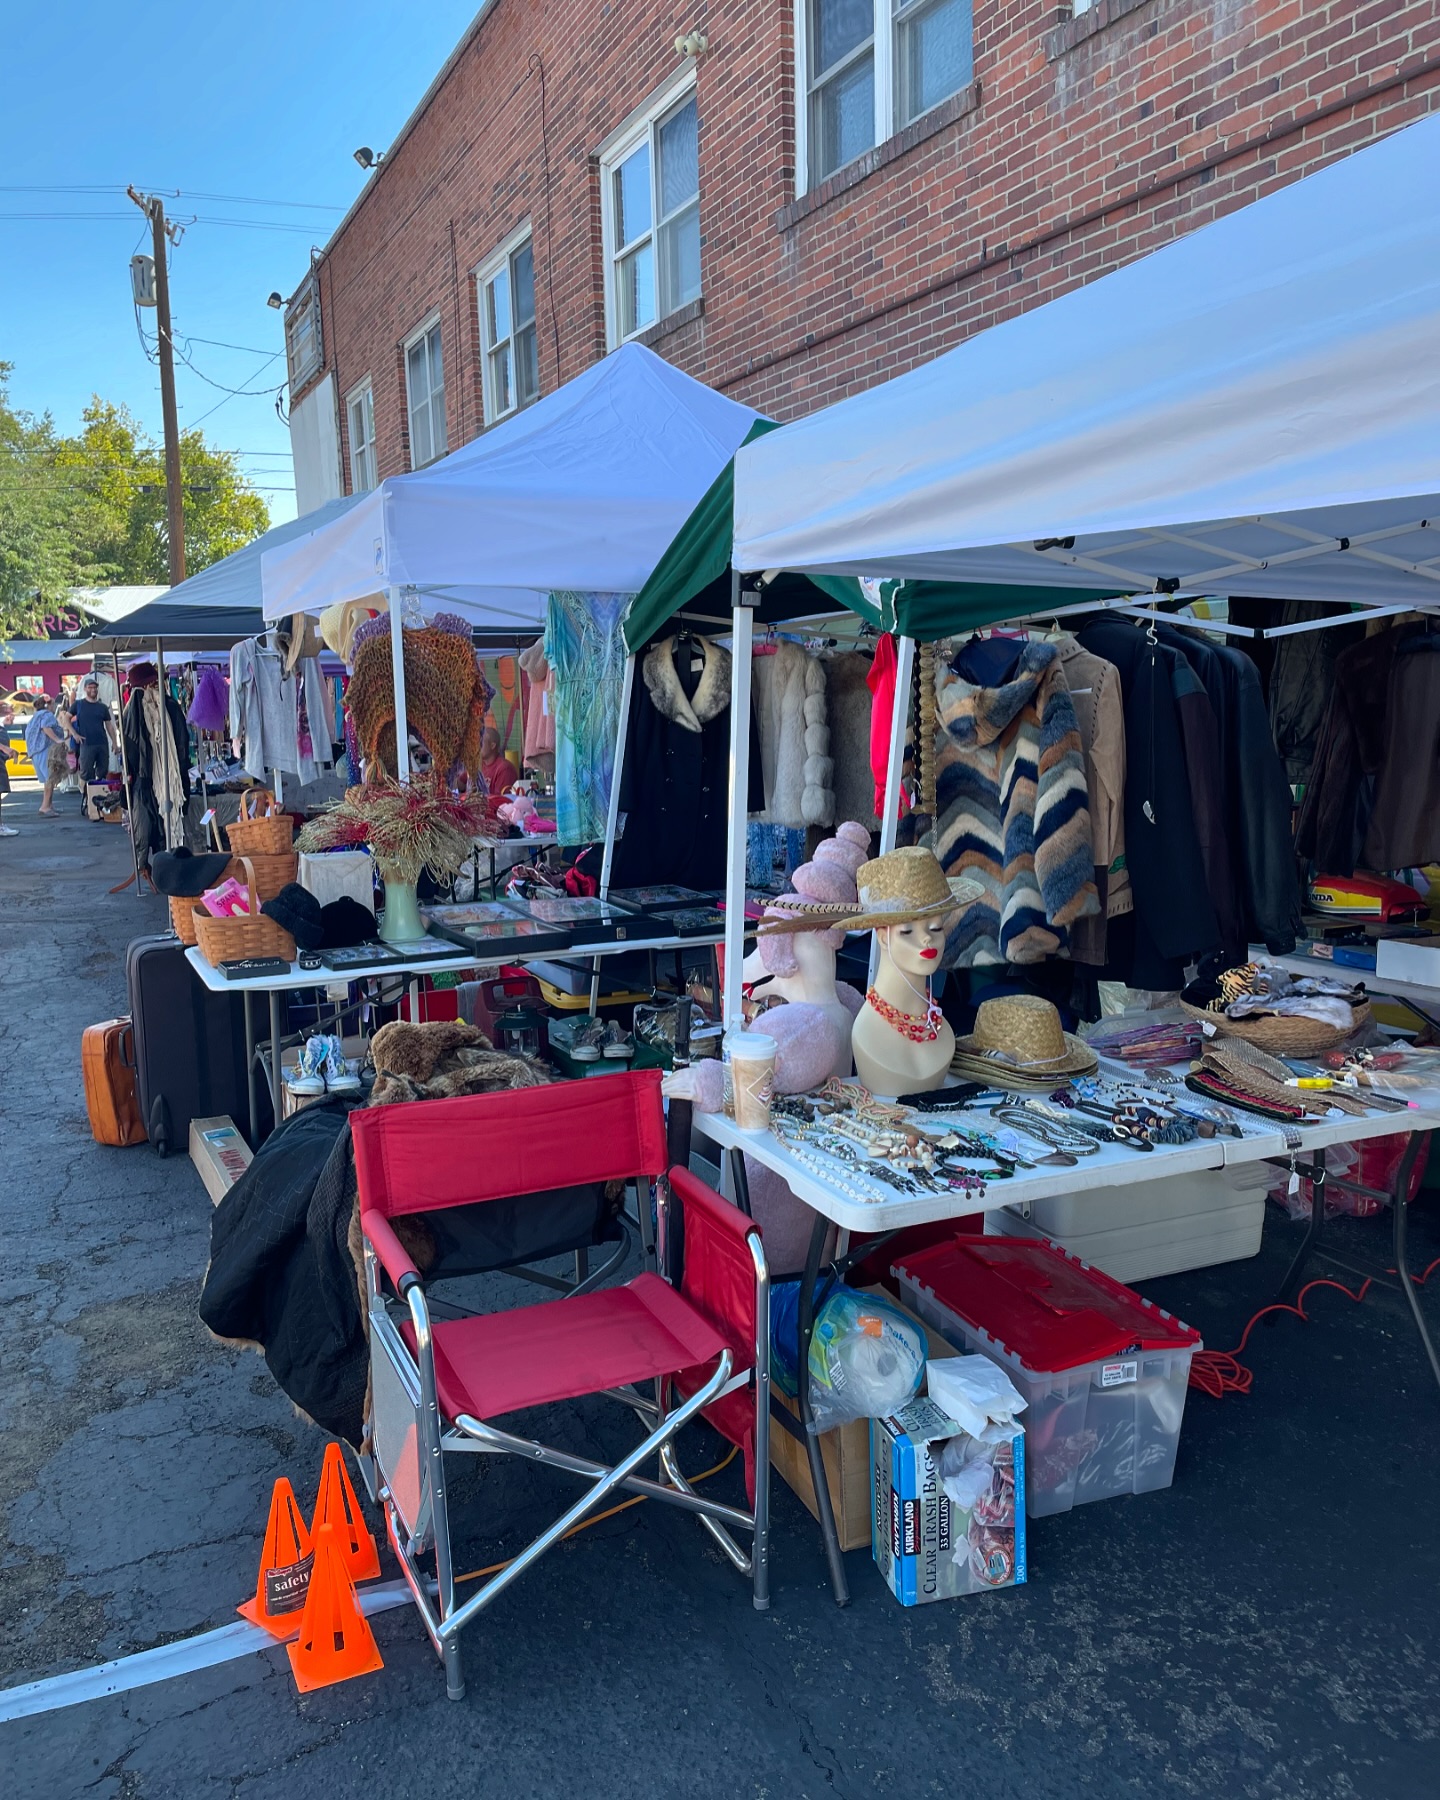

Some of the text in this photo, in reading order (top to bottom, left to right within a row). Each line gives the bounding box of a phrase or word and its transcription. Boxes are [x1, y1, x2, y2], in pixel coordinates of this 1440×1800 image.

[1308, 893, 1334, 902] ONDA
[905, 1501, 914, 1553] KIRKLAND
[923, 1498, 936, 1547] TRASH
[941, 1497, 949, 1549] 33 GALLON
[274, 1571, 309, 1592] safety
[923, 1549, 936, 1594] CLEAR
[1016, 1565, 1024, 1581] 200
